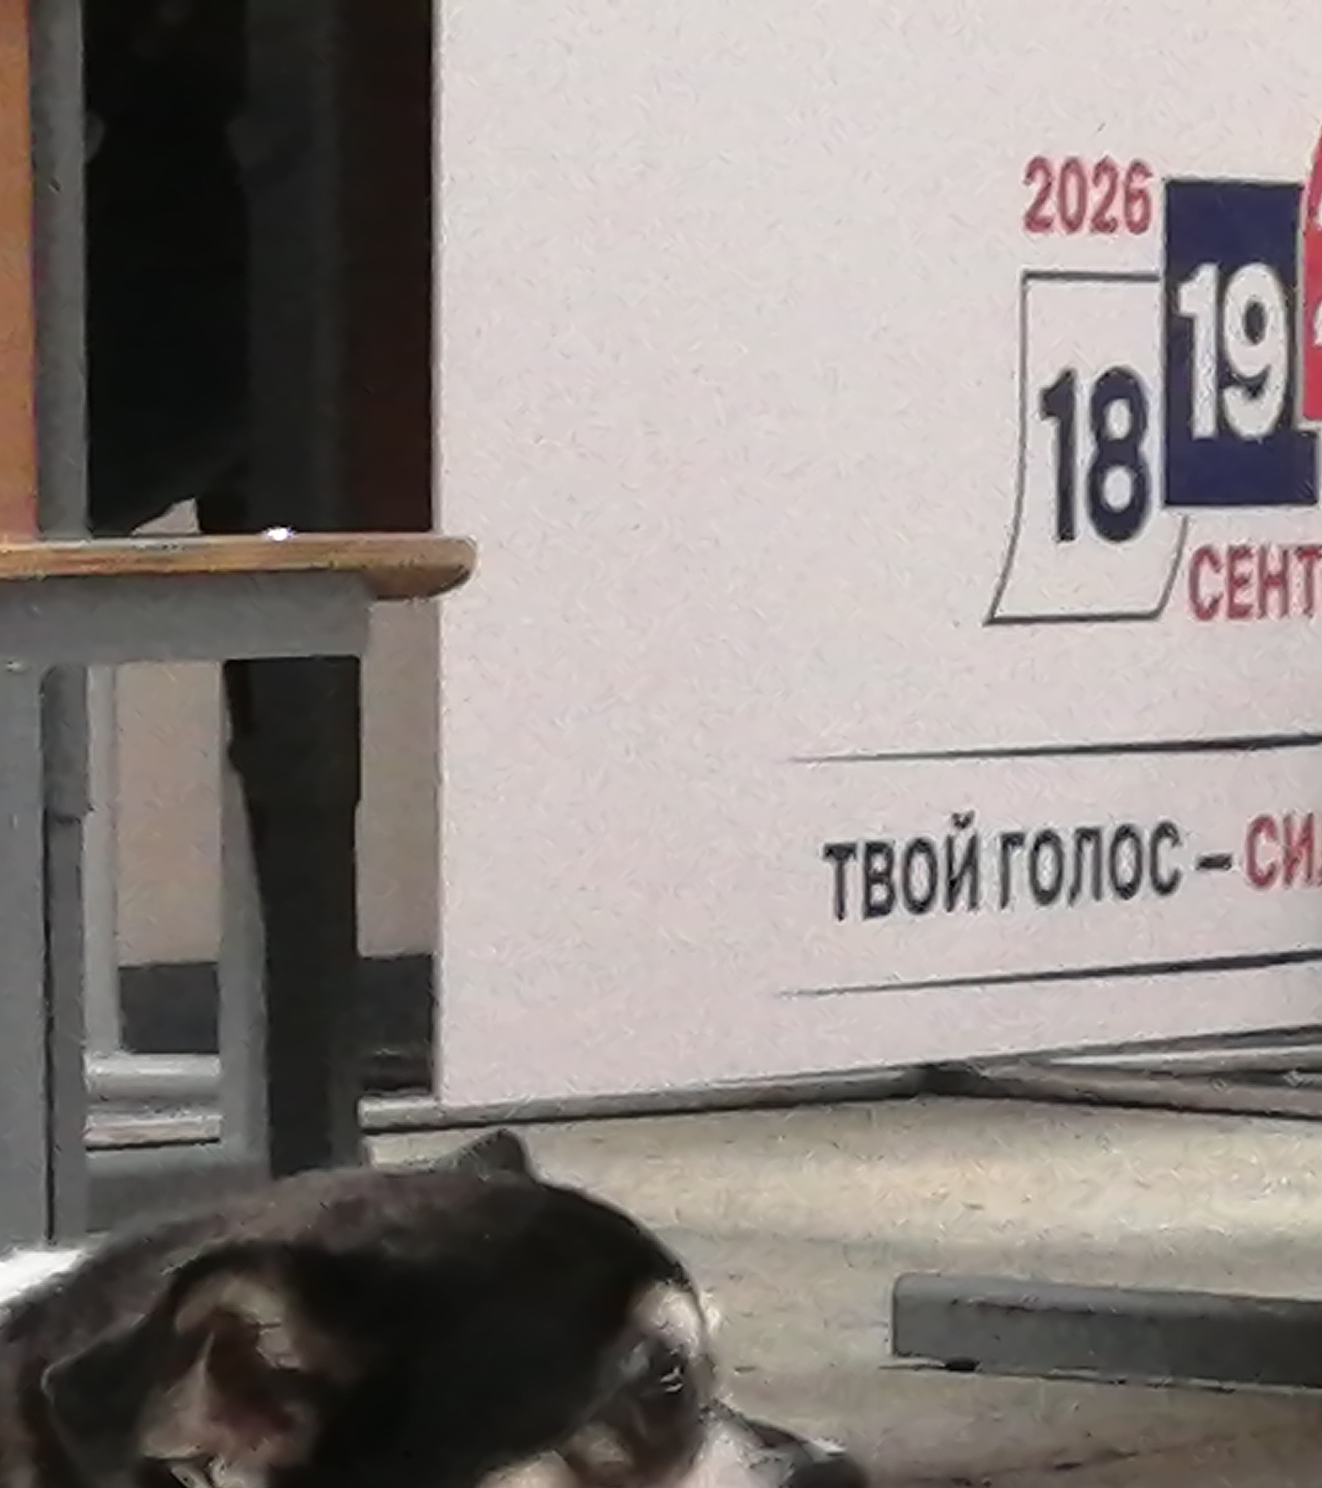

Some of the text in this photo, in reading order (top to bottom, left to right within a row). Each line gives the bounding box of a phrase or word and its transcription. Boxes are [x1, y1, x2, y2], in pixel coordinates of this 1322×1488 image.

[1022, 155, 1153, 235] 2026
[1178, 262, 1289, 440] 19
[1039, 366, 1151, 543] 18
[822, 811, 983, 922] ТВОЙ
[996, 819, 1183, 911] ГОЛОС
